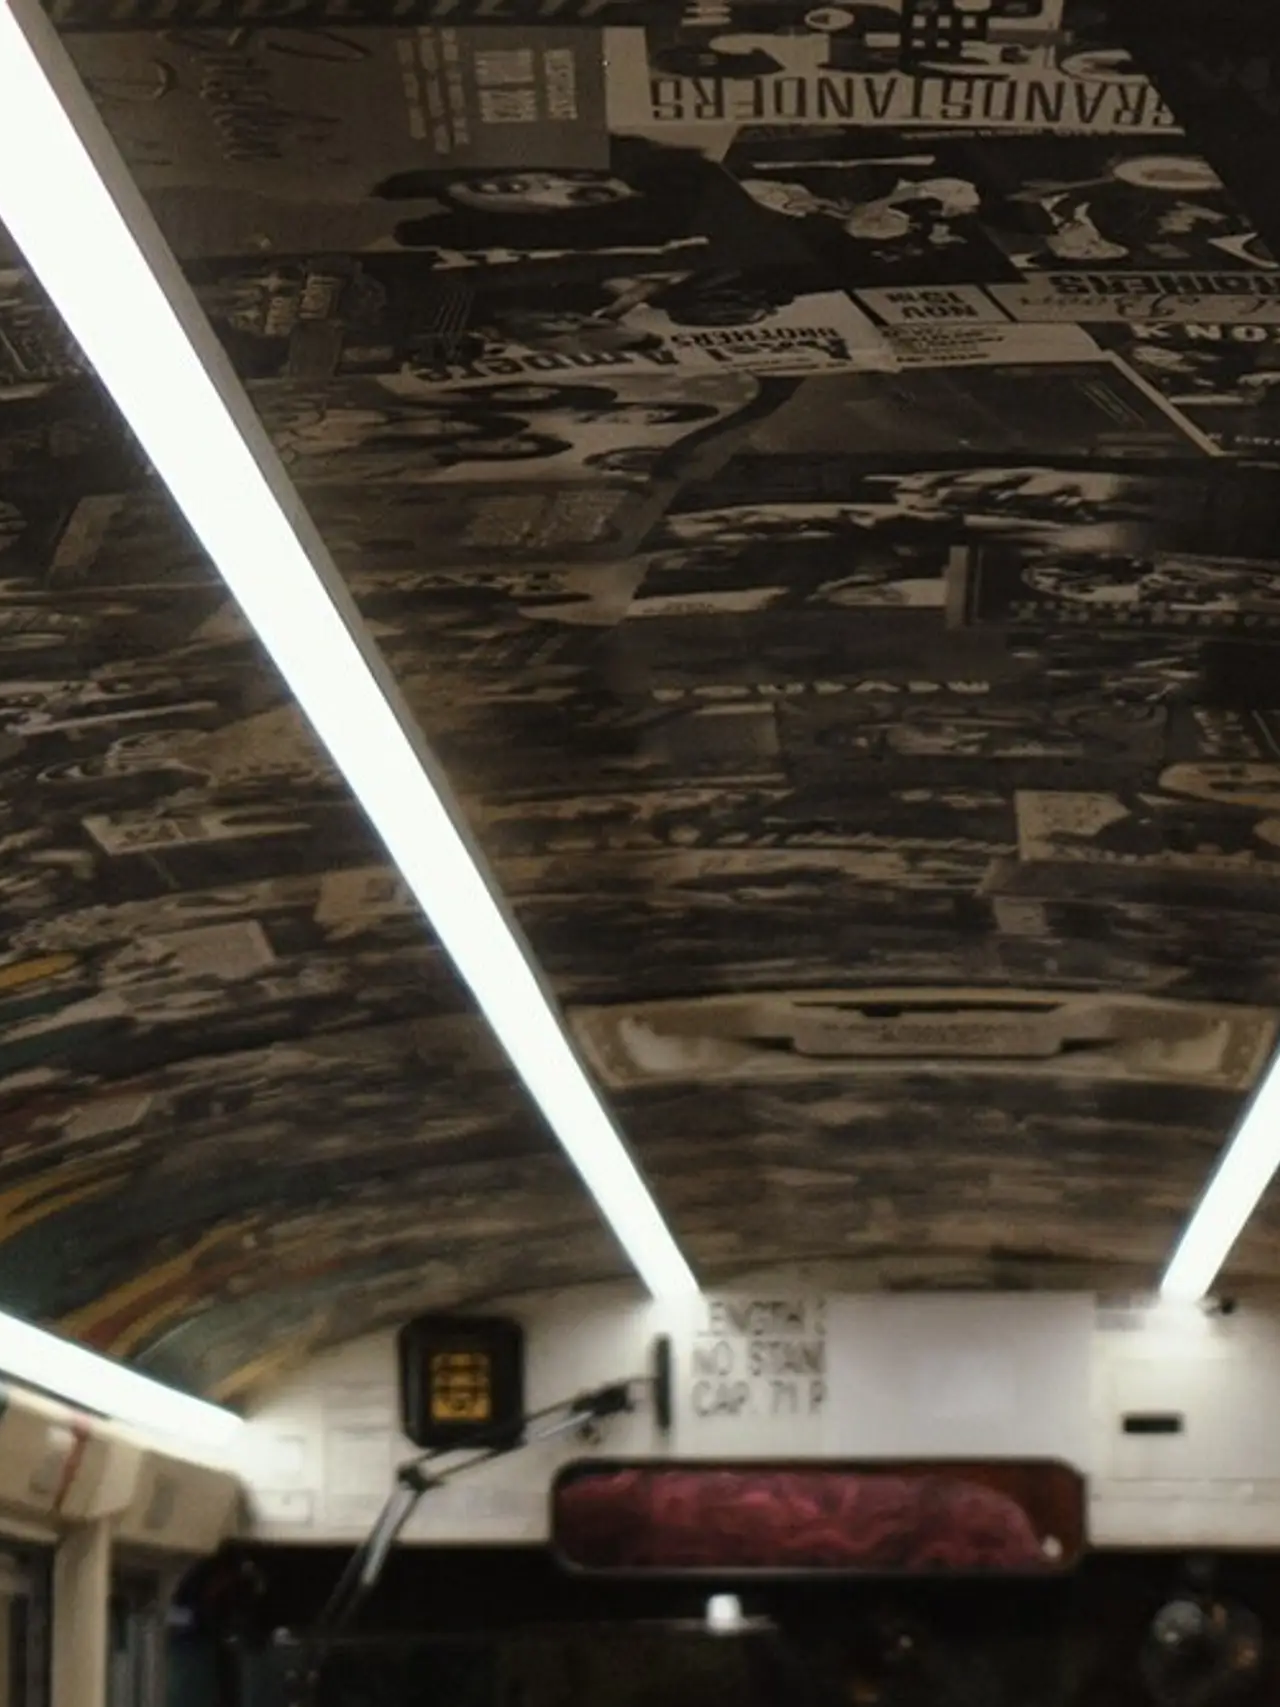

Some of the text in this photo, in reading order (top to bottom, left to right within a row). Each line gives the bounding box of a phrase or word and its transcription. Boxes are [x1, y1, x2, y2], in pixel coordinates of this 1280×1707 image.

[902, 304, 978, 319] NOV
[671, 328, 841, 346] BROTHERS
[693, 1340, 734, 1377] NO
